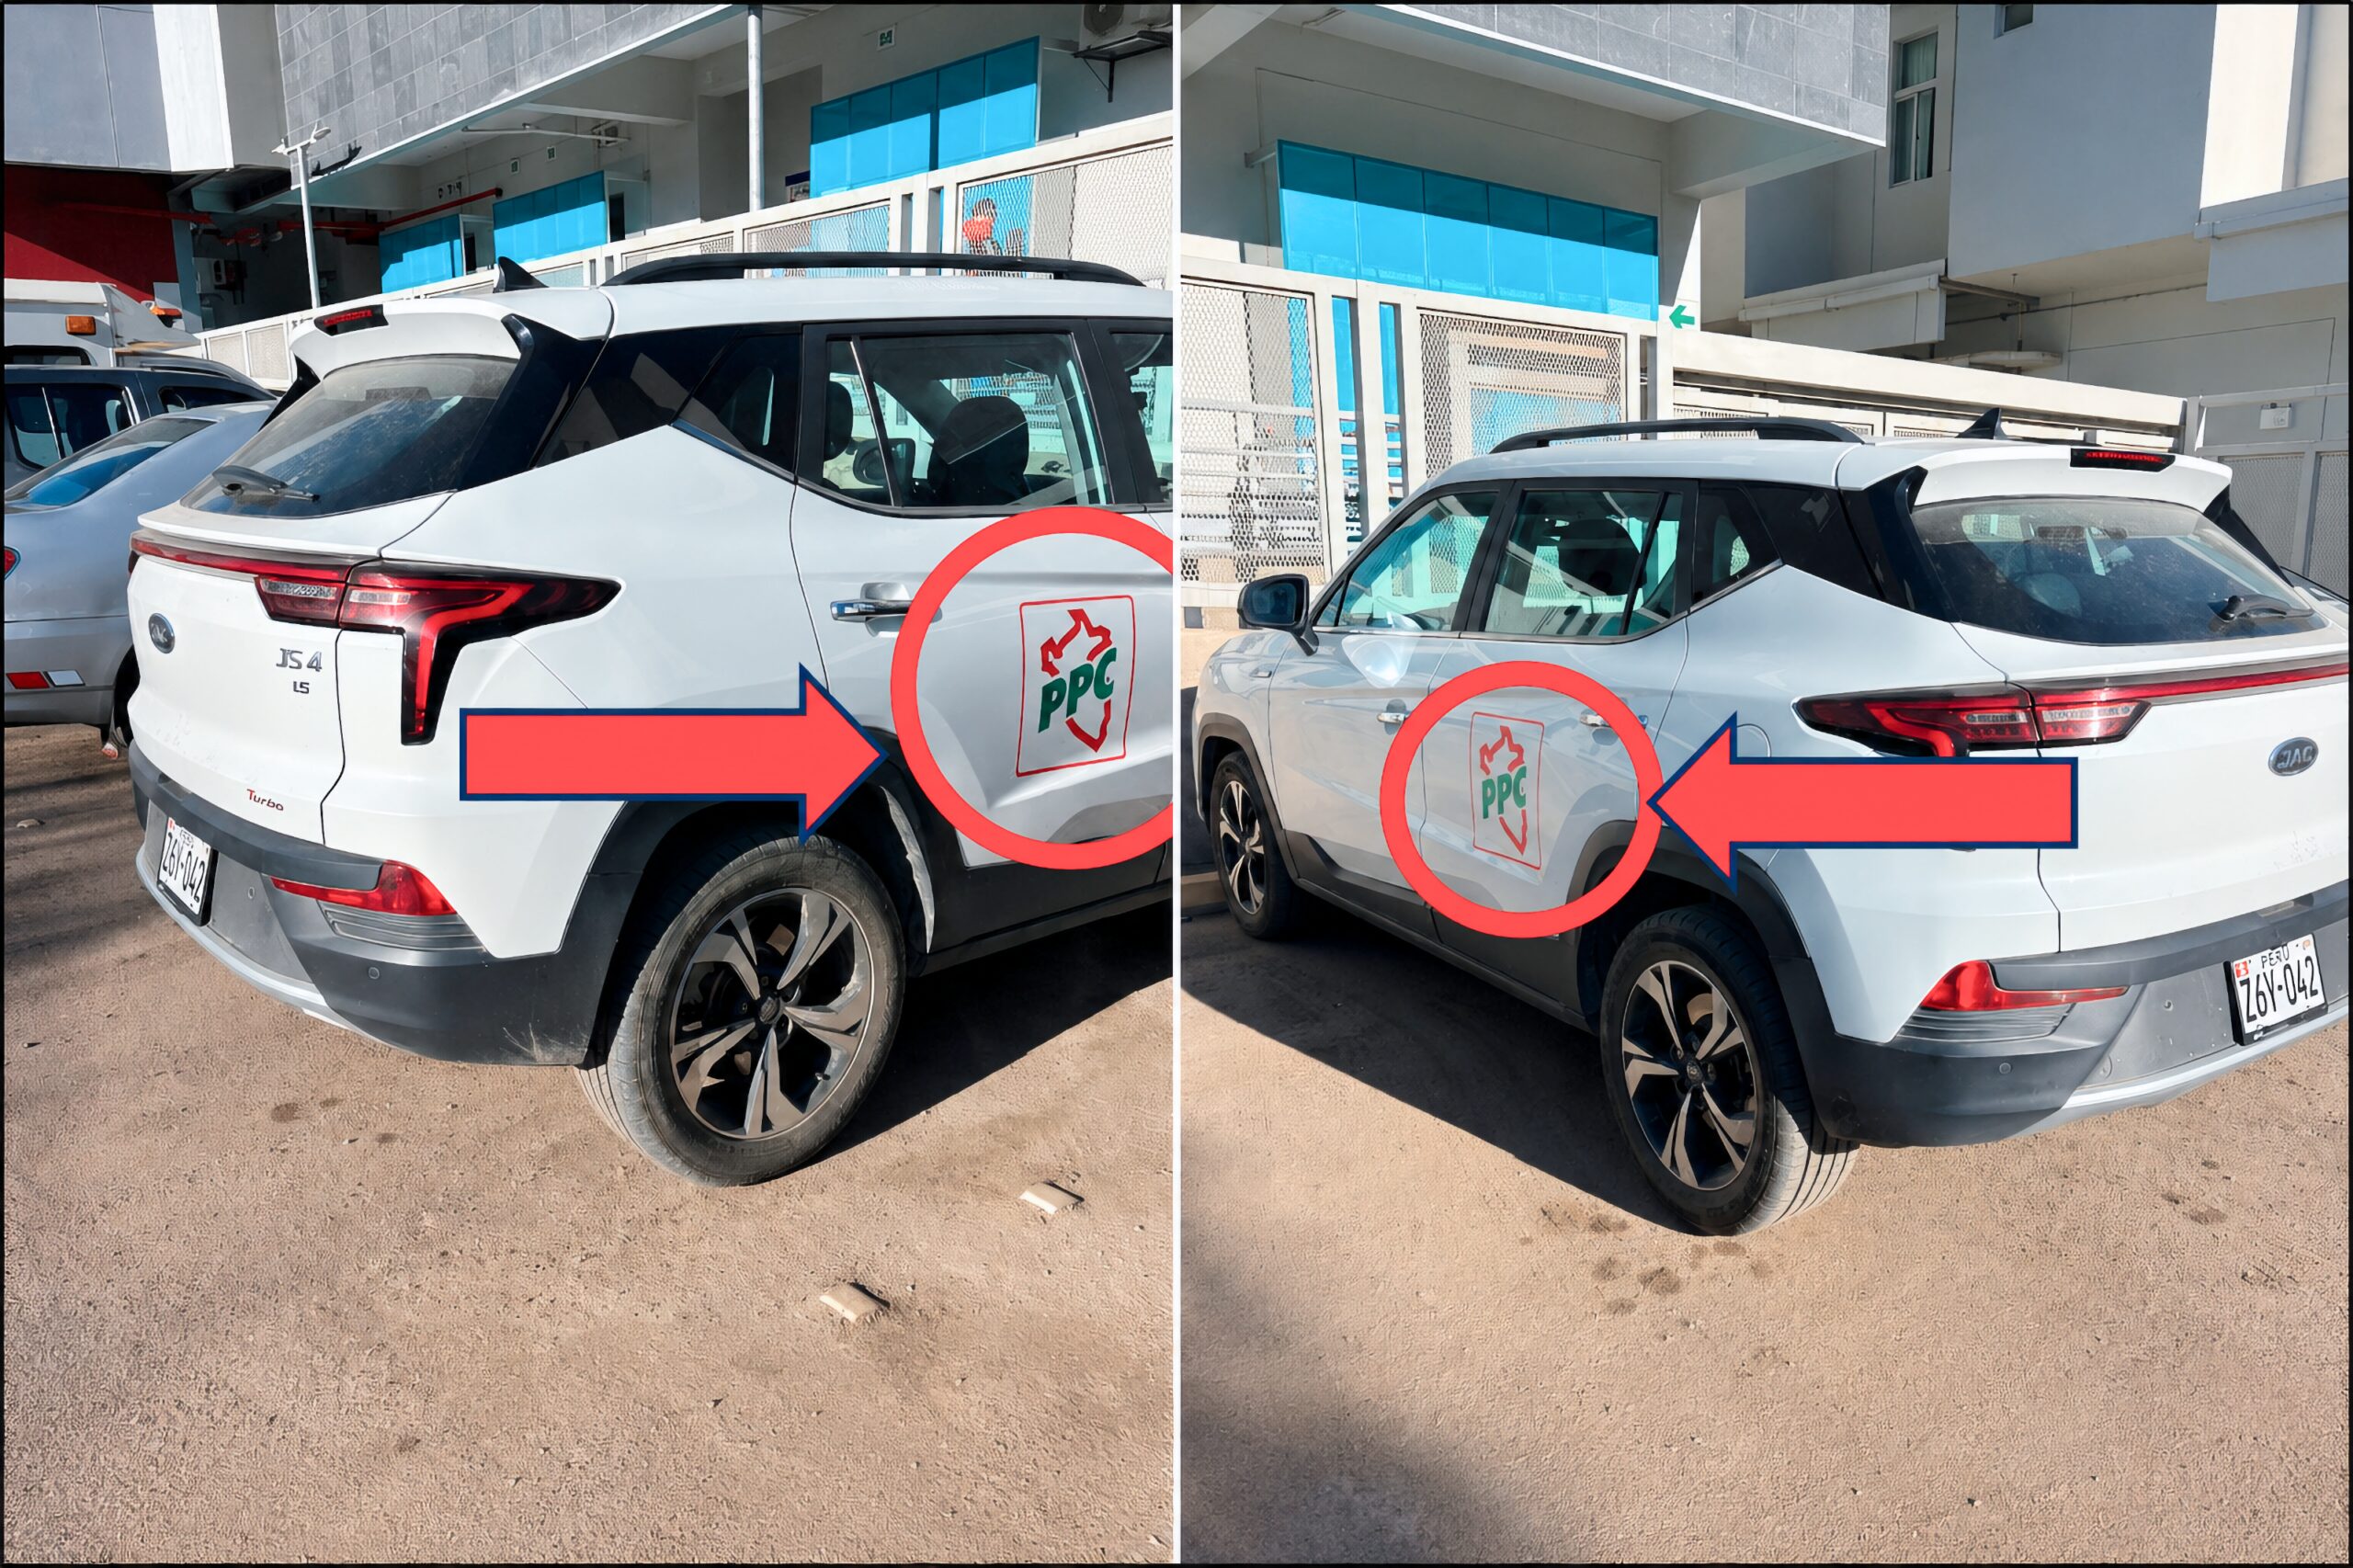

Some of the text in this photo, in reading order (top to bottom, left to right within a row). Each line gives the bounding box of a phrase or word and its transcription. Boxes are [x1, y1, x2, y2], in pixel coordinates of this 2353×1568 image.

[1038, 647, 1117, 733] PPC
[2277, 745, 2313, 769] JAC
[246, 788, 284, 812] Turbo
[1482, 766, 1527, 819] PPC
[163, 832, 205, 903] Z6Y-042
[2239, 956, 2318, 1023] Z6Y-042
